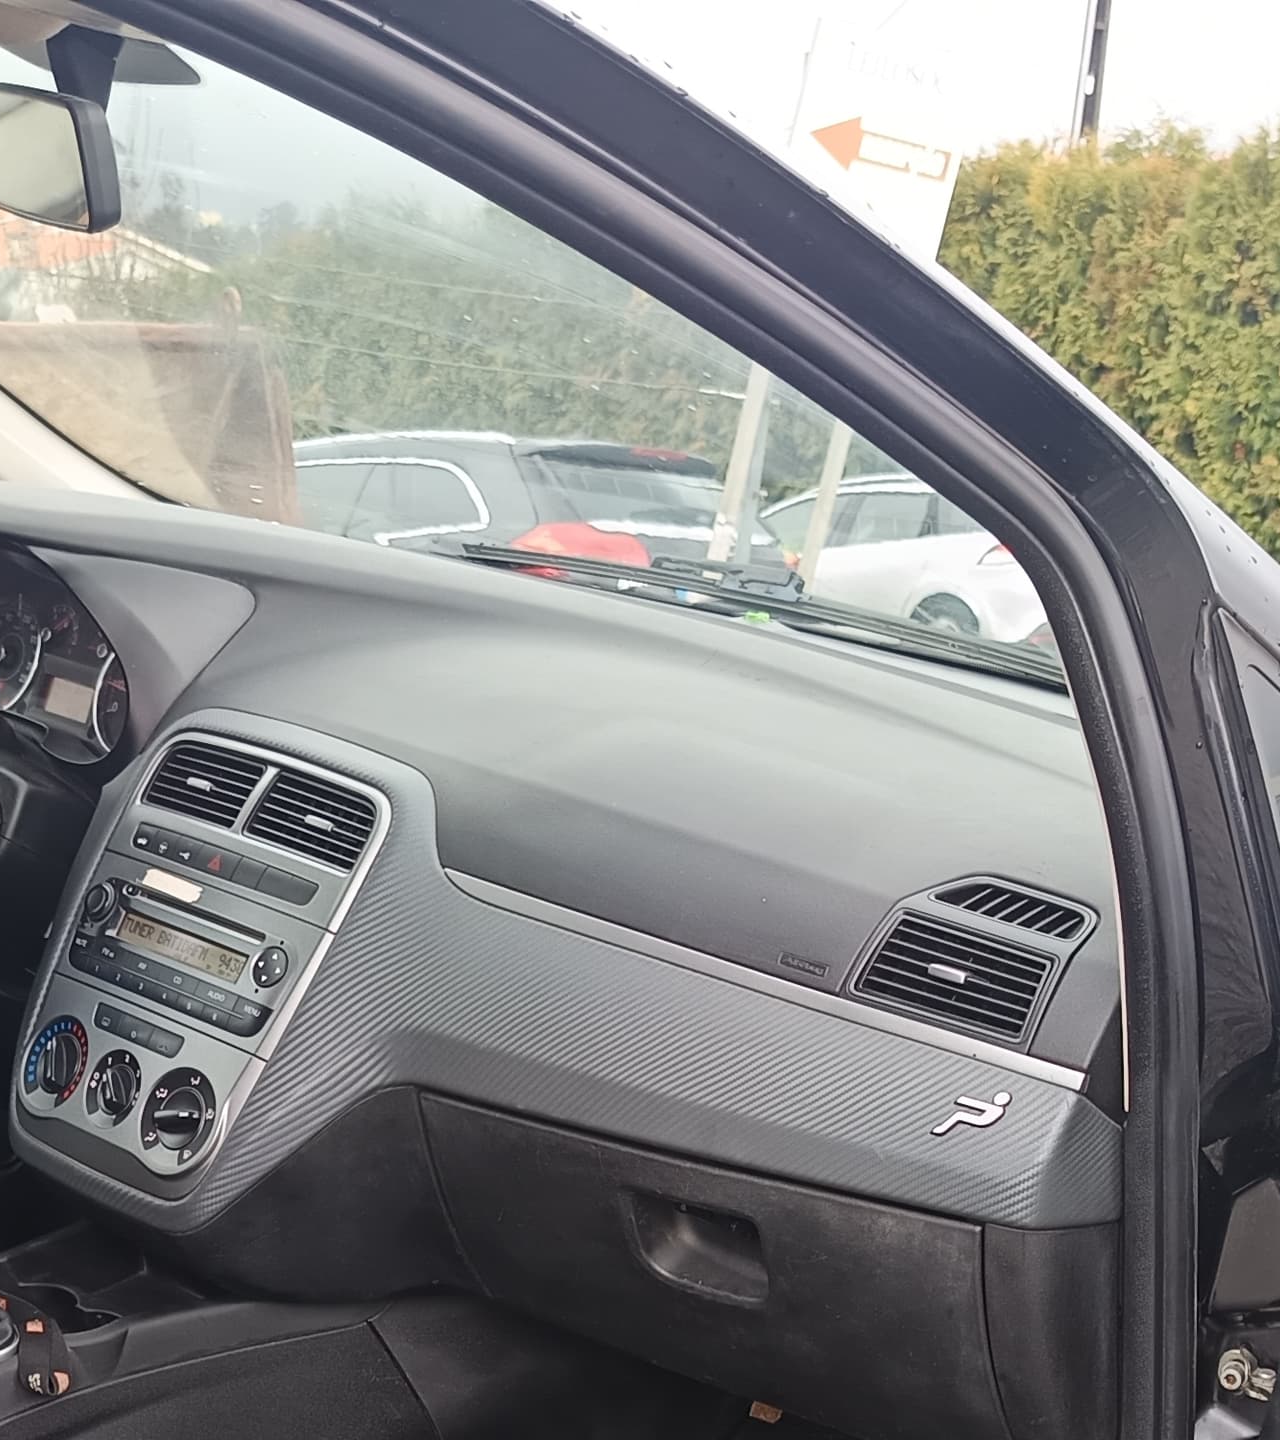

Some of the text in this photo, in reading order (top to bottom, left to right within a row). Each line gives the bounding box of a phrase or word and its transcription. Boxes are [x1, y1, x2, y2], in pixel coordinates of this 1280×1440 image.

[123, 917, 156, 940] TUNER
[208, 990, 225, 1001] AUDIO
[244, 1004, 261, 1017] MENU
